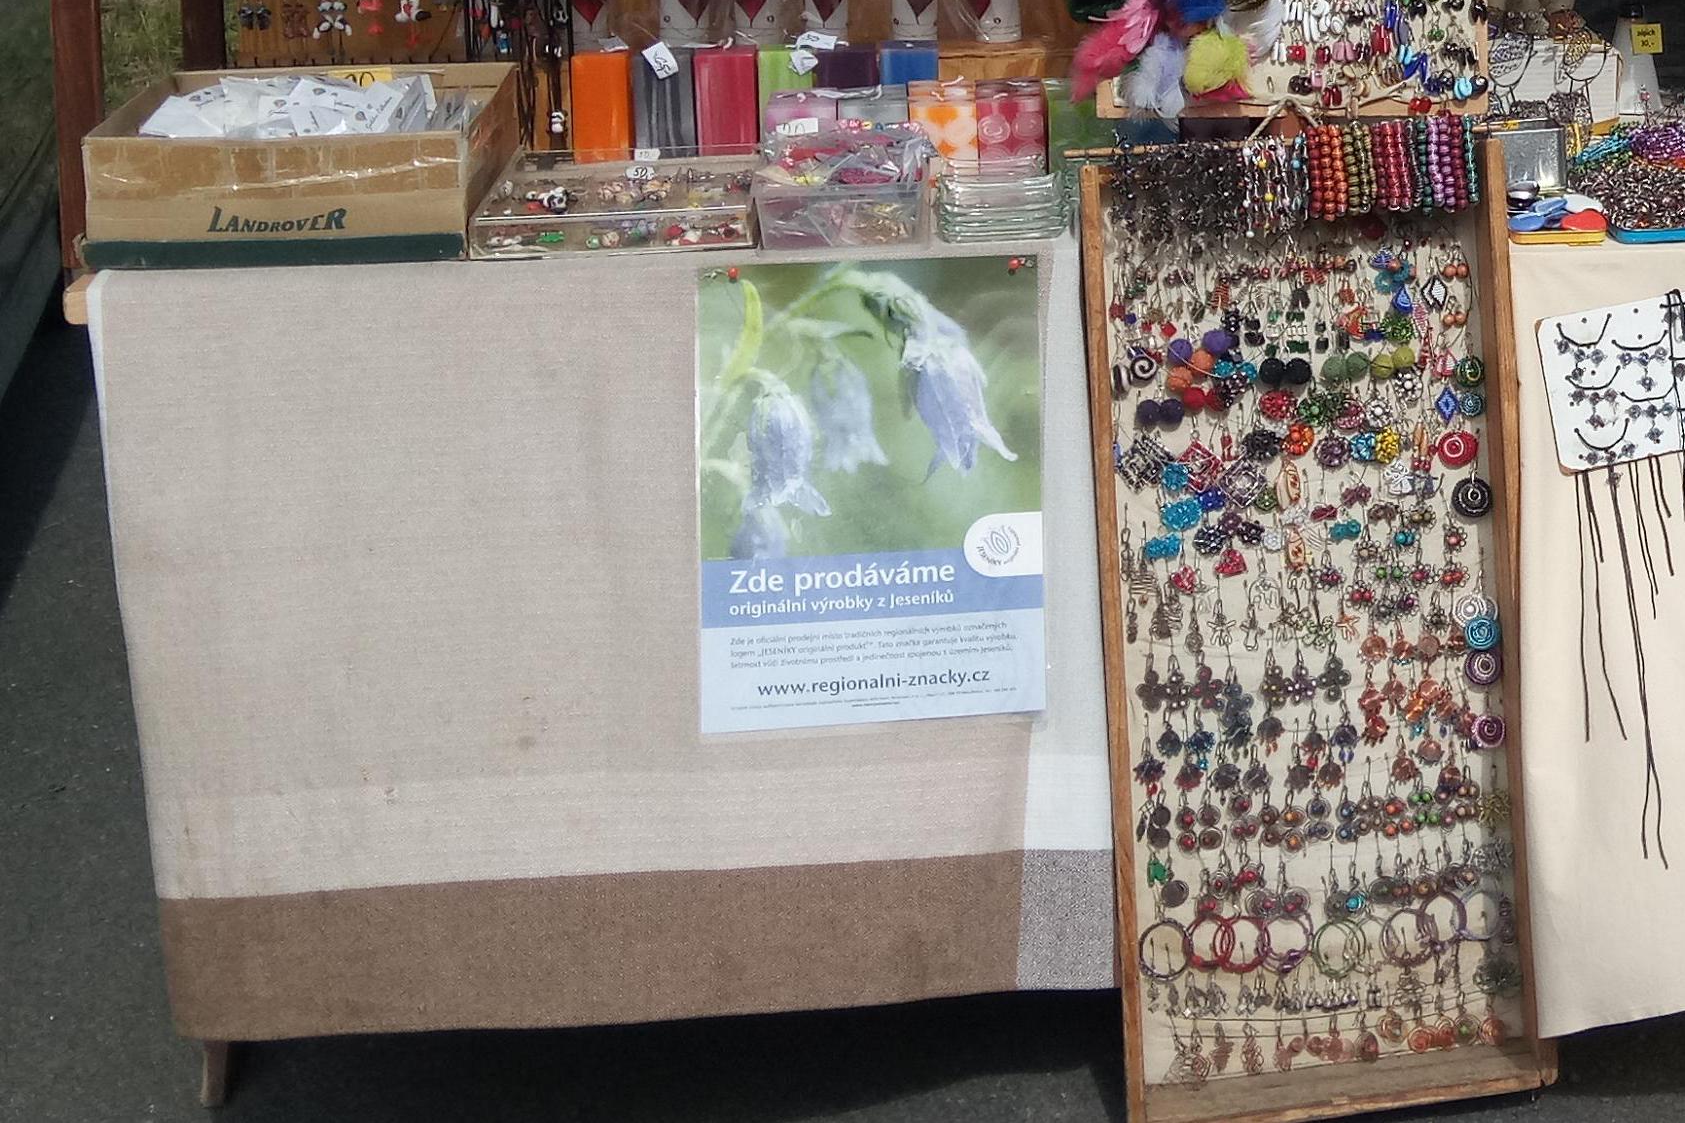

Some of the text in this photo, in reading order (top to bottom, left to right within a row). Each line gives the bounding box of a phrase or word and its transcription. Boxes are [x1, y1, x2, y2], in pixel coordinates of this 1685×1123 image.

[207, 206, 348, 233] LANDROVER
[729, 561, 955, 596] Zde prodáváme
[729, 588, 954, 618] originální výrobky z Jeseníků
[758, 668, 990, 696] www.regionalni-znacky.cz
